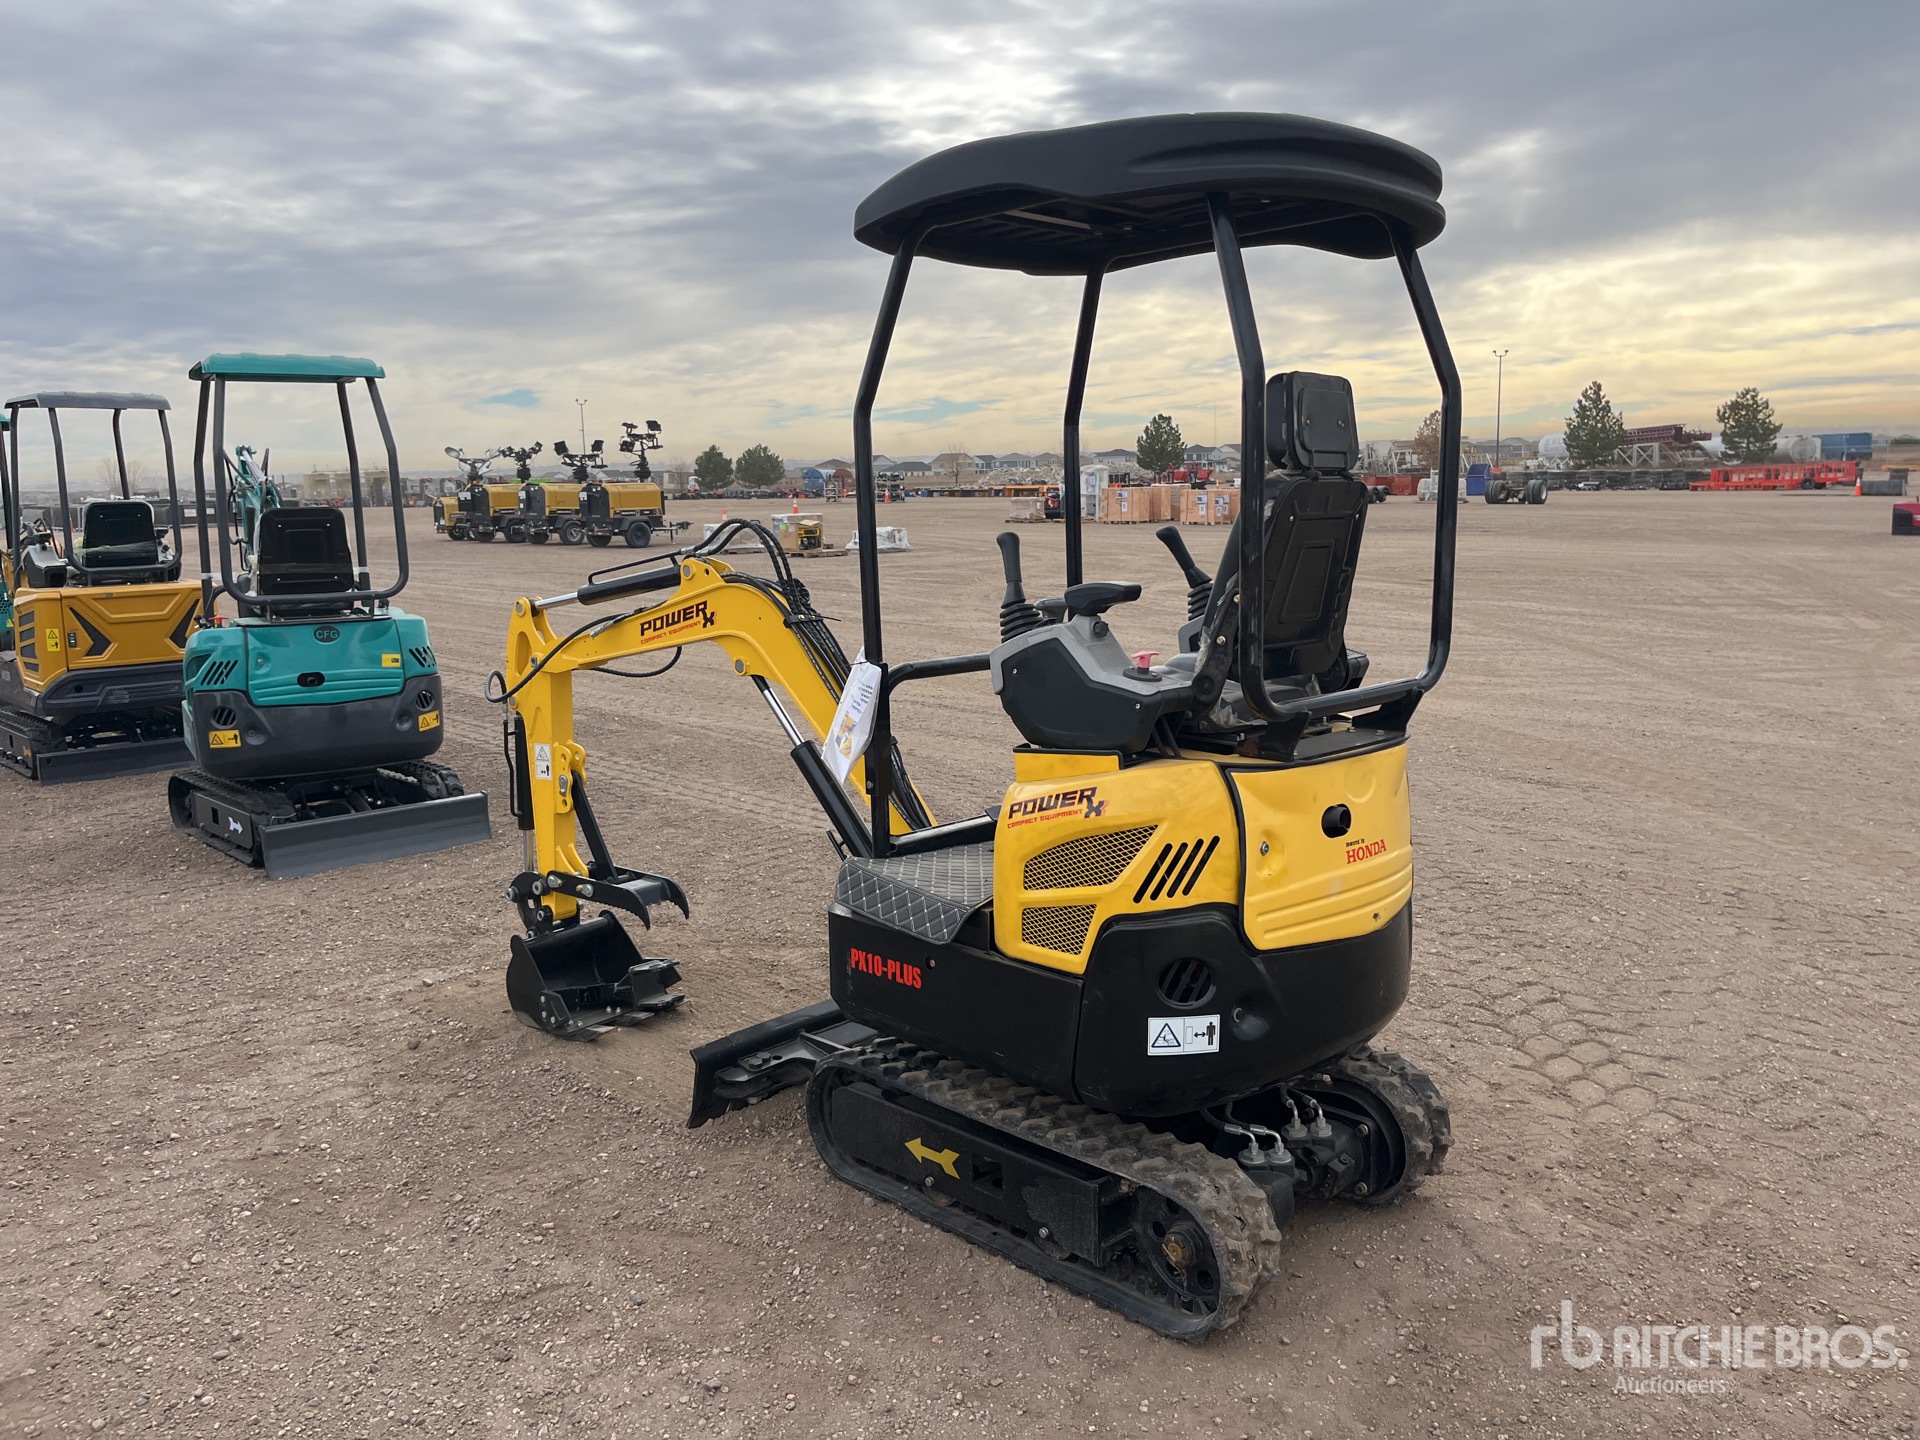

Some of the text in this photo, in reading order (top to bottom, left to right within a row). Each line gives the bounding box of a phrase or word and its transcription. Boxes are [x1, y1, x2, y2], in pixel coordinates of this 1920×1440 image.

[316, 630, 339, 639] CFG
[668, 620, 701, 636] EQUIPMENT
[1007, 808, 1083, 829] COMPACT EQUIPMENT
[1345, 838, 1387, 865] HONDA
[850, 947, 922, 989] PX10-PLUS
